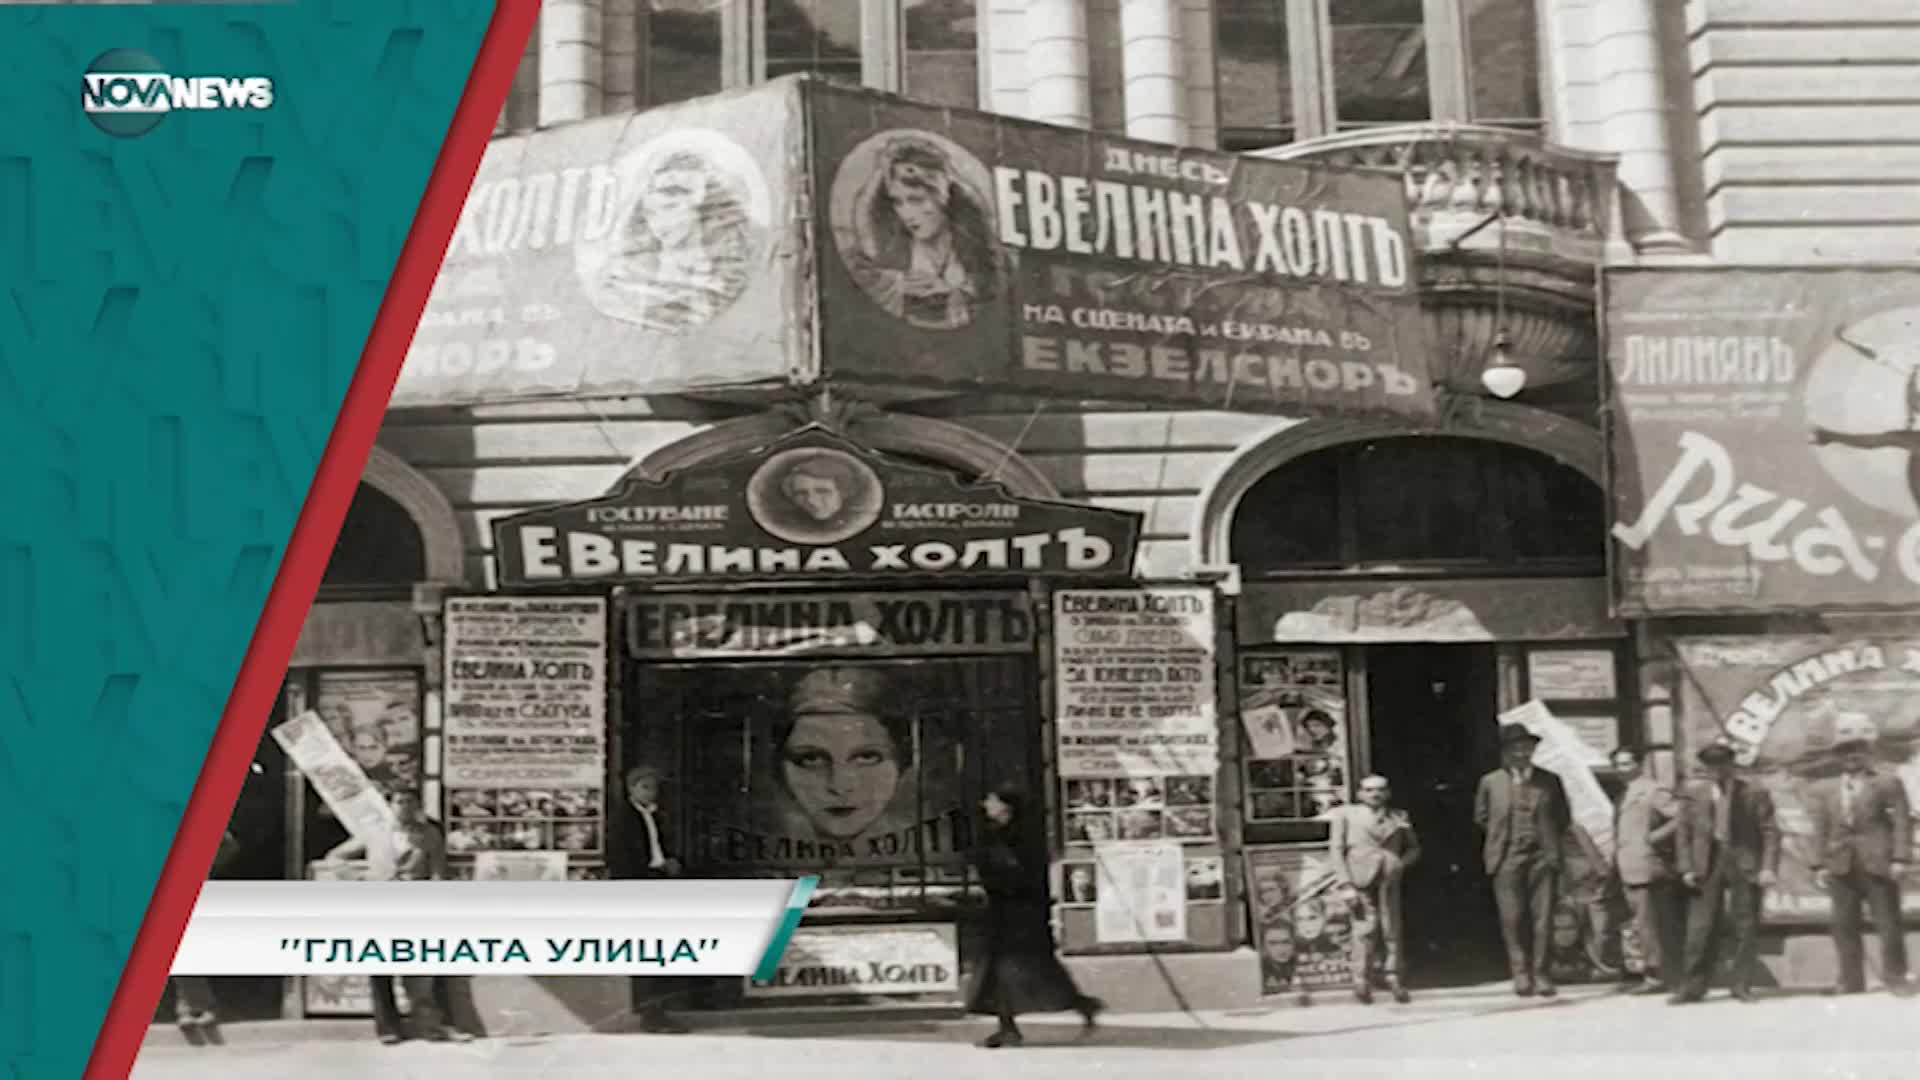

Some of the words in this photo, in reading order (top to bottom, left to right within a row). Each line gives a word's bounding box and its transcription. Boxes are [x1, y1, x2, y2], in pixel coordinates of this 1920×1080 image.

[992, 165, 1244, 271] ЕВЕЛИНА
[1249, 200, 1406, 286] ХОЛТЪ
[1022, 336, 1417, 397] ЕКЗЕЛСИОРЪ
[519, 524, 851, 579] ЕВЕЛИНА
[868, 526, 1113, 573] ХОЛТЪ
[632, 602, 855, 648] ЕВЕЛИНА
[874, 601, 1030, 646] ХОЛТЪ
